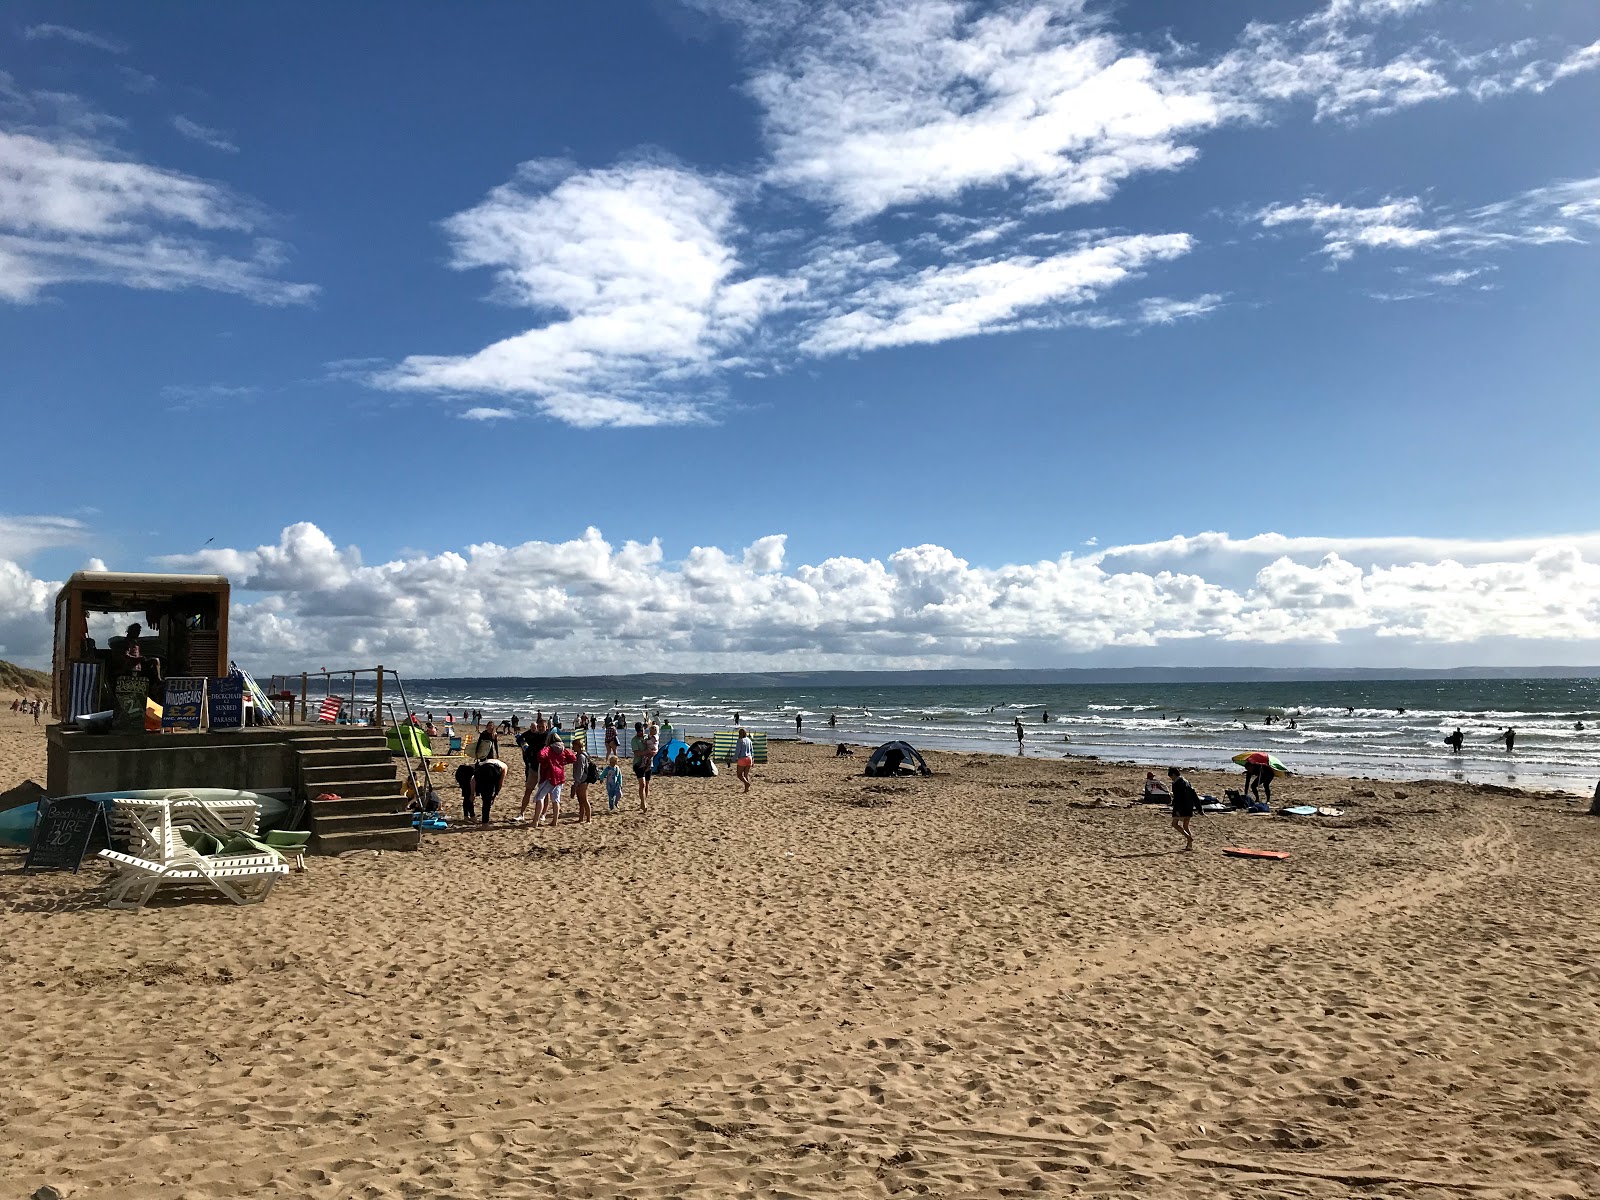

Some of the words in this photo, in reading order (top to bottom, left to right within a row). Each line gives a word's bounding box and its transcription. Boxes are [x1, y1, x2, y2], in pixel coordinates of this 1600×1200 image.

[167, 680, 203, 691] HIRE
[165, 691, 202, 706] WINDBREAKS
[168, 705, 197, 717] £2
[52, 819, 87, 833] HIRE
